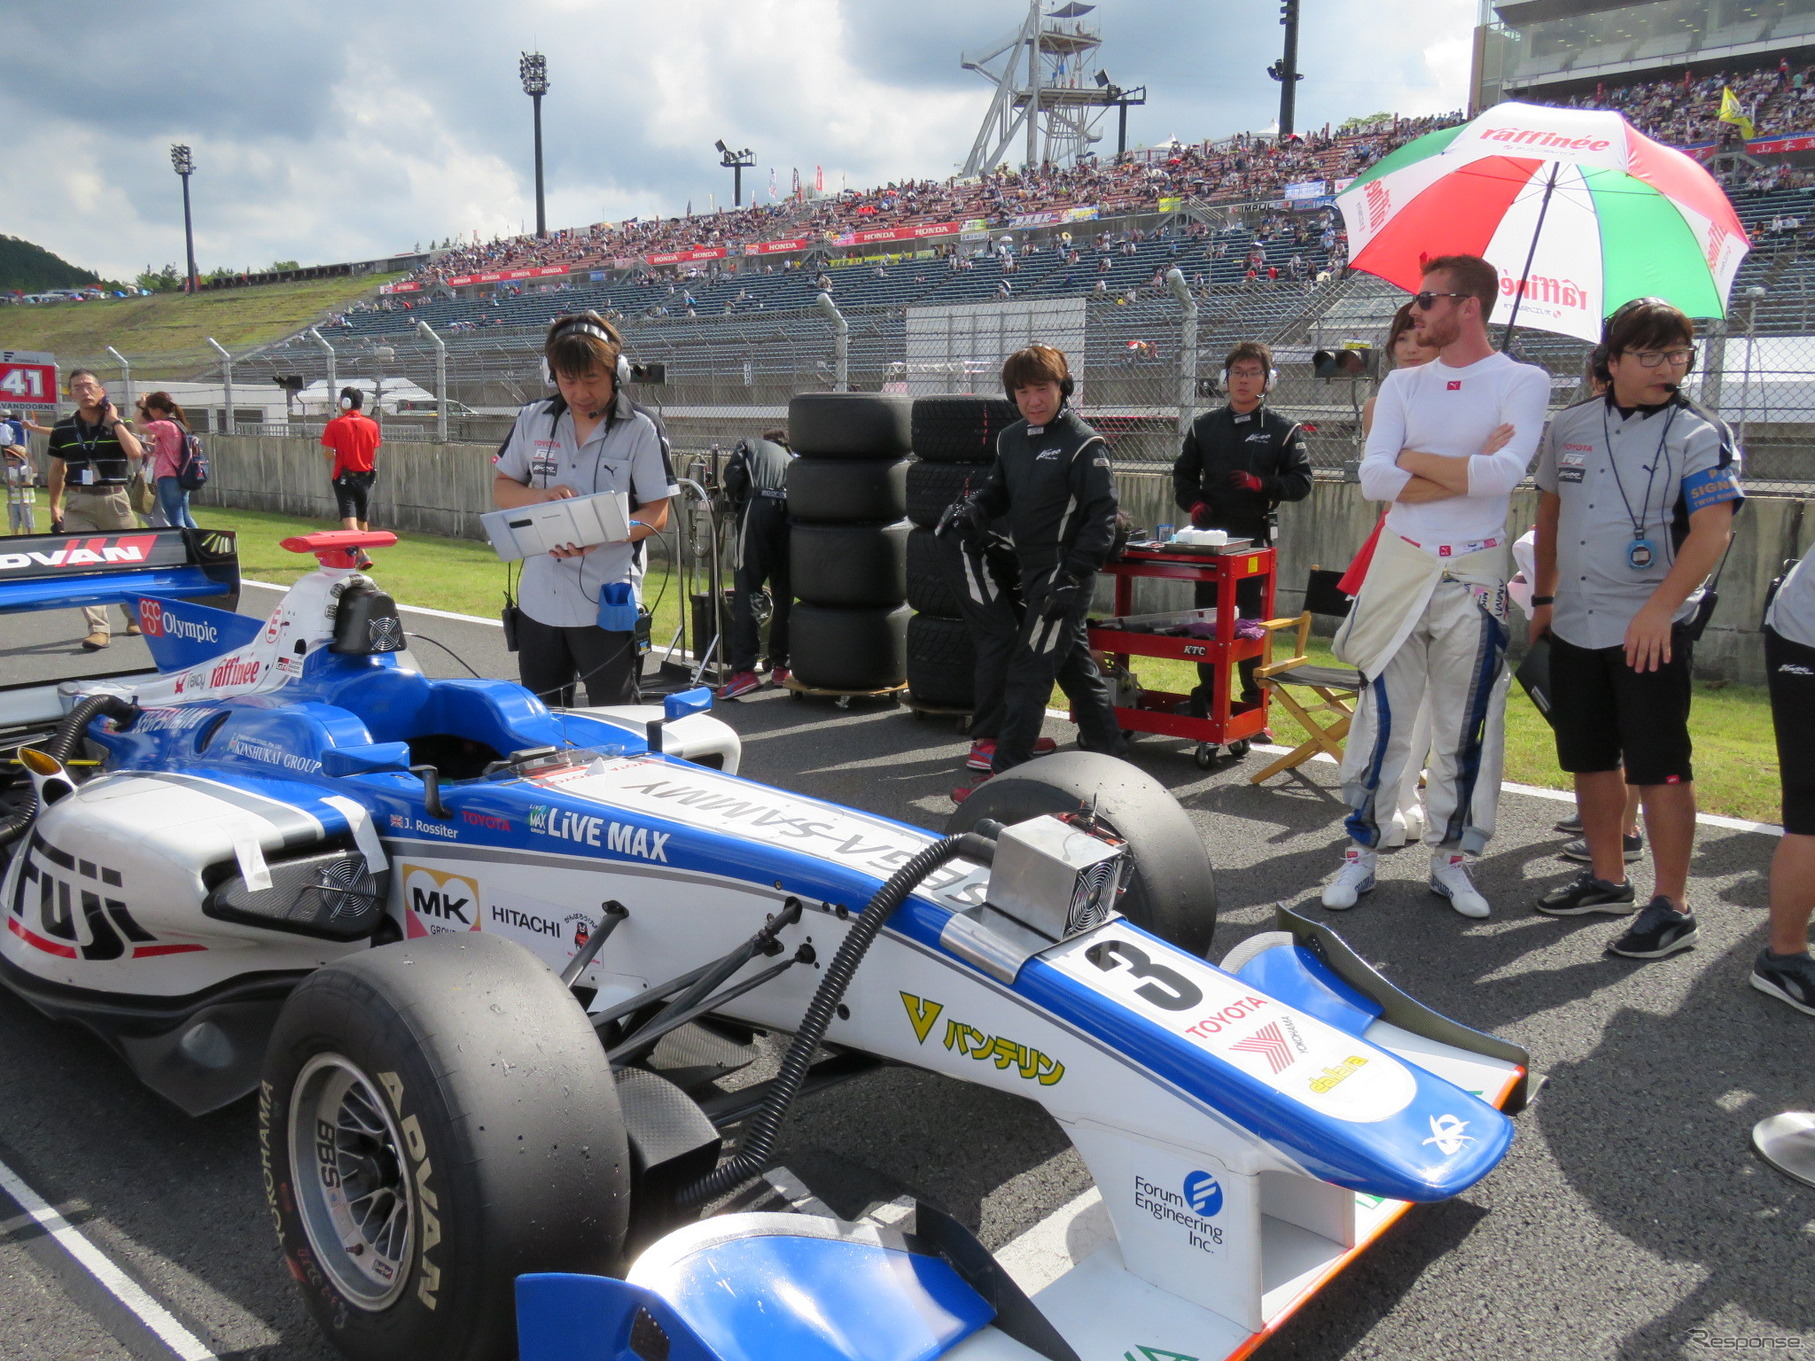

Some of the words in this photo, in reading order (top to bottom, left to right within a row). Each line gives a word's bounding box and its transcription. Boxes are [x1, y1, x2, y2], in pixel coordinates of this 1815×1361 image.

[1480, 127, 1610, 152] raffinée
[863, 232, 896, 241] HONDA
[915, 226, 948, 236] HONDA
[653, 255, 678, 263] HONDA
[692, 251, 719, 259] HONDA
[768, 242, 798, 251] HONDA
[541, 267, 563, 275] HONDA
[1, 369, 44, 397] 41
[533, 440, 561, 448] TOYOTA
[1562, 443, 1593, 452] TOYOTA
[0, 546, 143, 570] DVAN
[162, 611, 219, 644] Olympic
[1183, 645, 1206, 656] KTC
[209, 651, 260, 689] raffinée
[234, 741, 281, 766] KINSHUKAI
[283, 753, 323, 774] GROUP
[404, 817, 413, 830] J.
[416, 819, 459, 839] Rossiter
[461, 810, 511, 832] TOYOTA
[530, 812, 547, 830] MAX
[607, 821, 671, 863] MAX
[413, 886, 471, 926] MK
[430, 923, 457, 935] GRO
[492, 905, 561, 939] HITACHI
[1084, 939, 1204, 1012] 3
[1185, 995, 1269, 1040] TOYOTA
[1281, 1015, 1310, 1055] YOKOHAMA
[943, 1018, 1066, 1086] バンテリン
[1308, 1055, 1370, 1094] dallara
[258, 1079, 286, 1246] YOKOHAMA
[316, 1118, 341, 1189] BBS
[377, 1071, 442, 1311] ADVAN
[1135, 1175, 1184, 1208] Forum
[1135, 1191, 1223, 1245] Engineering
[1189, 1230, 1214, 1254] Inc.
